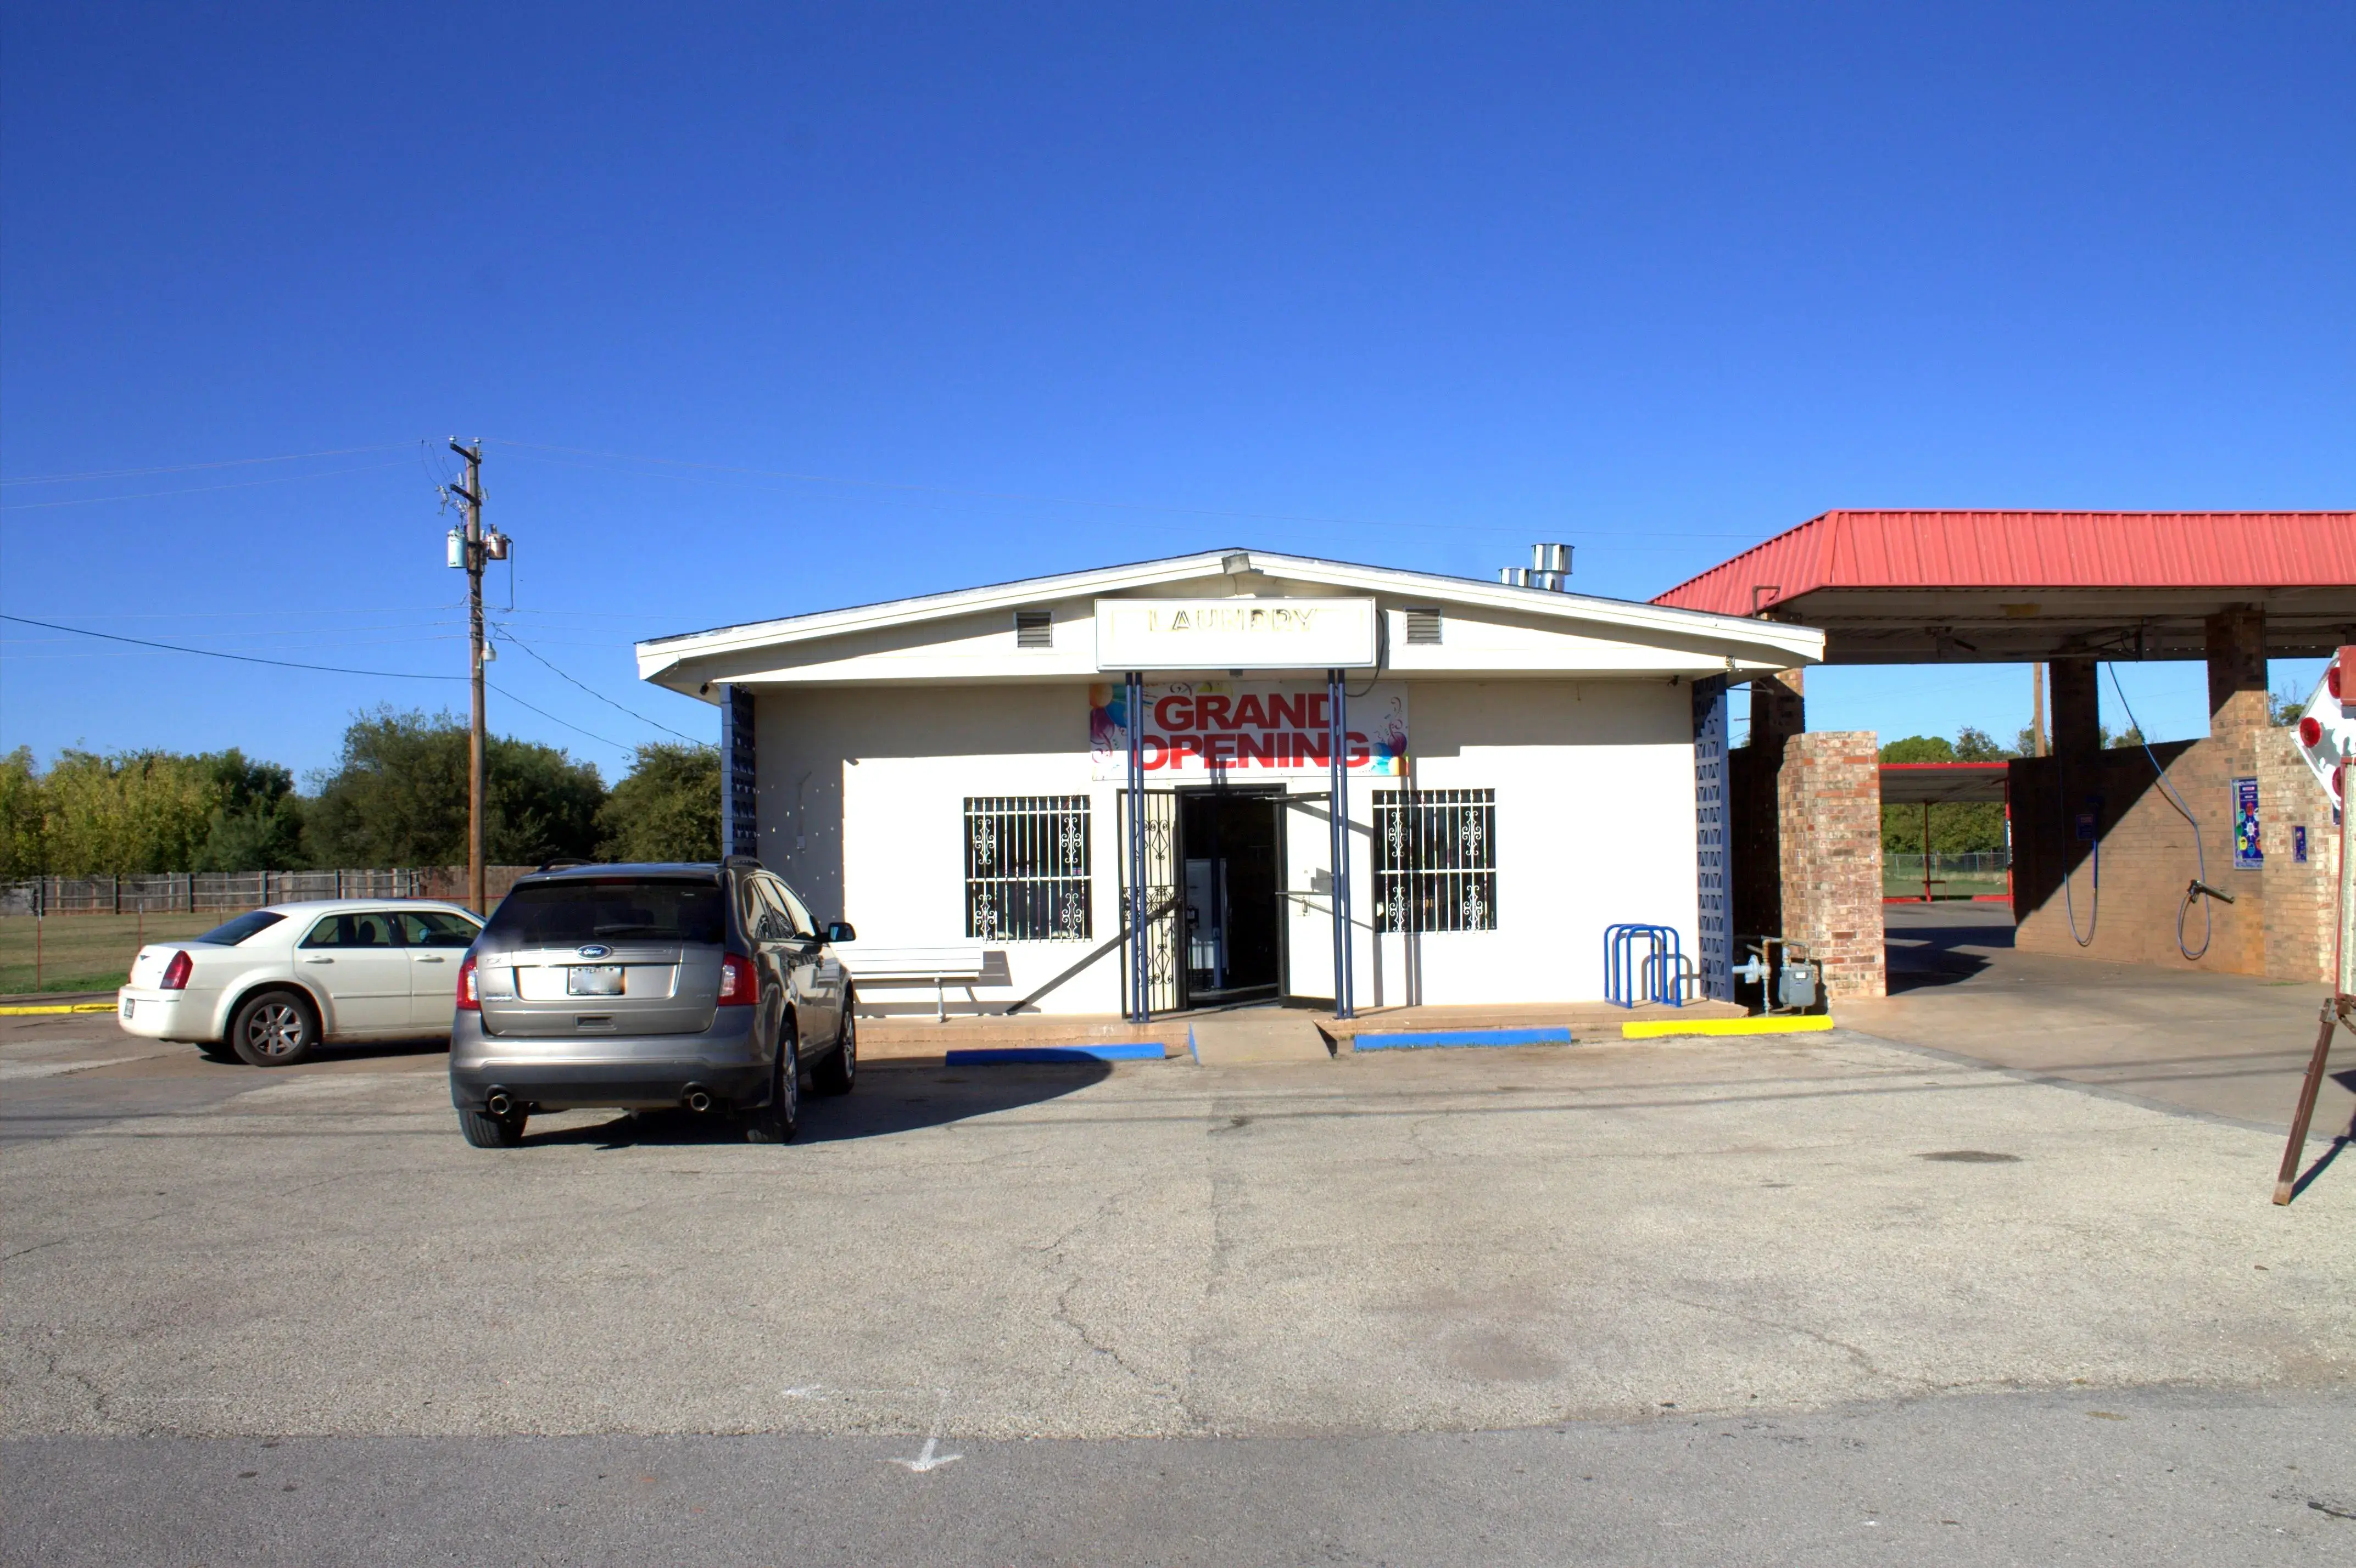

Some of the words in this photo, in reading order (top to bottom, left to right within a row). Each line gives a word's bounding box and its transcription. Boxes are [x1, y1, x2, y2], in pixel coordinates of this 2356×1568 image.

[1149, 608, 1317, 631] LAUNDRY
[1154, 693, 1340, 731] GRAND
[1134, 731, 1370, 771] OPENING
